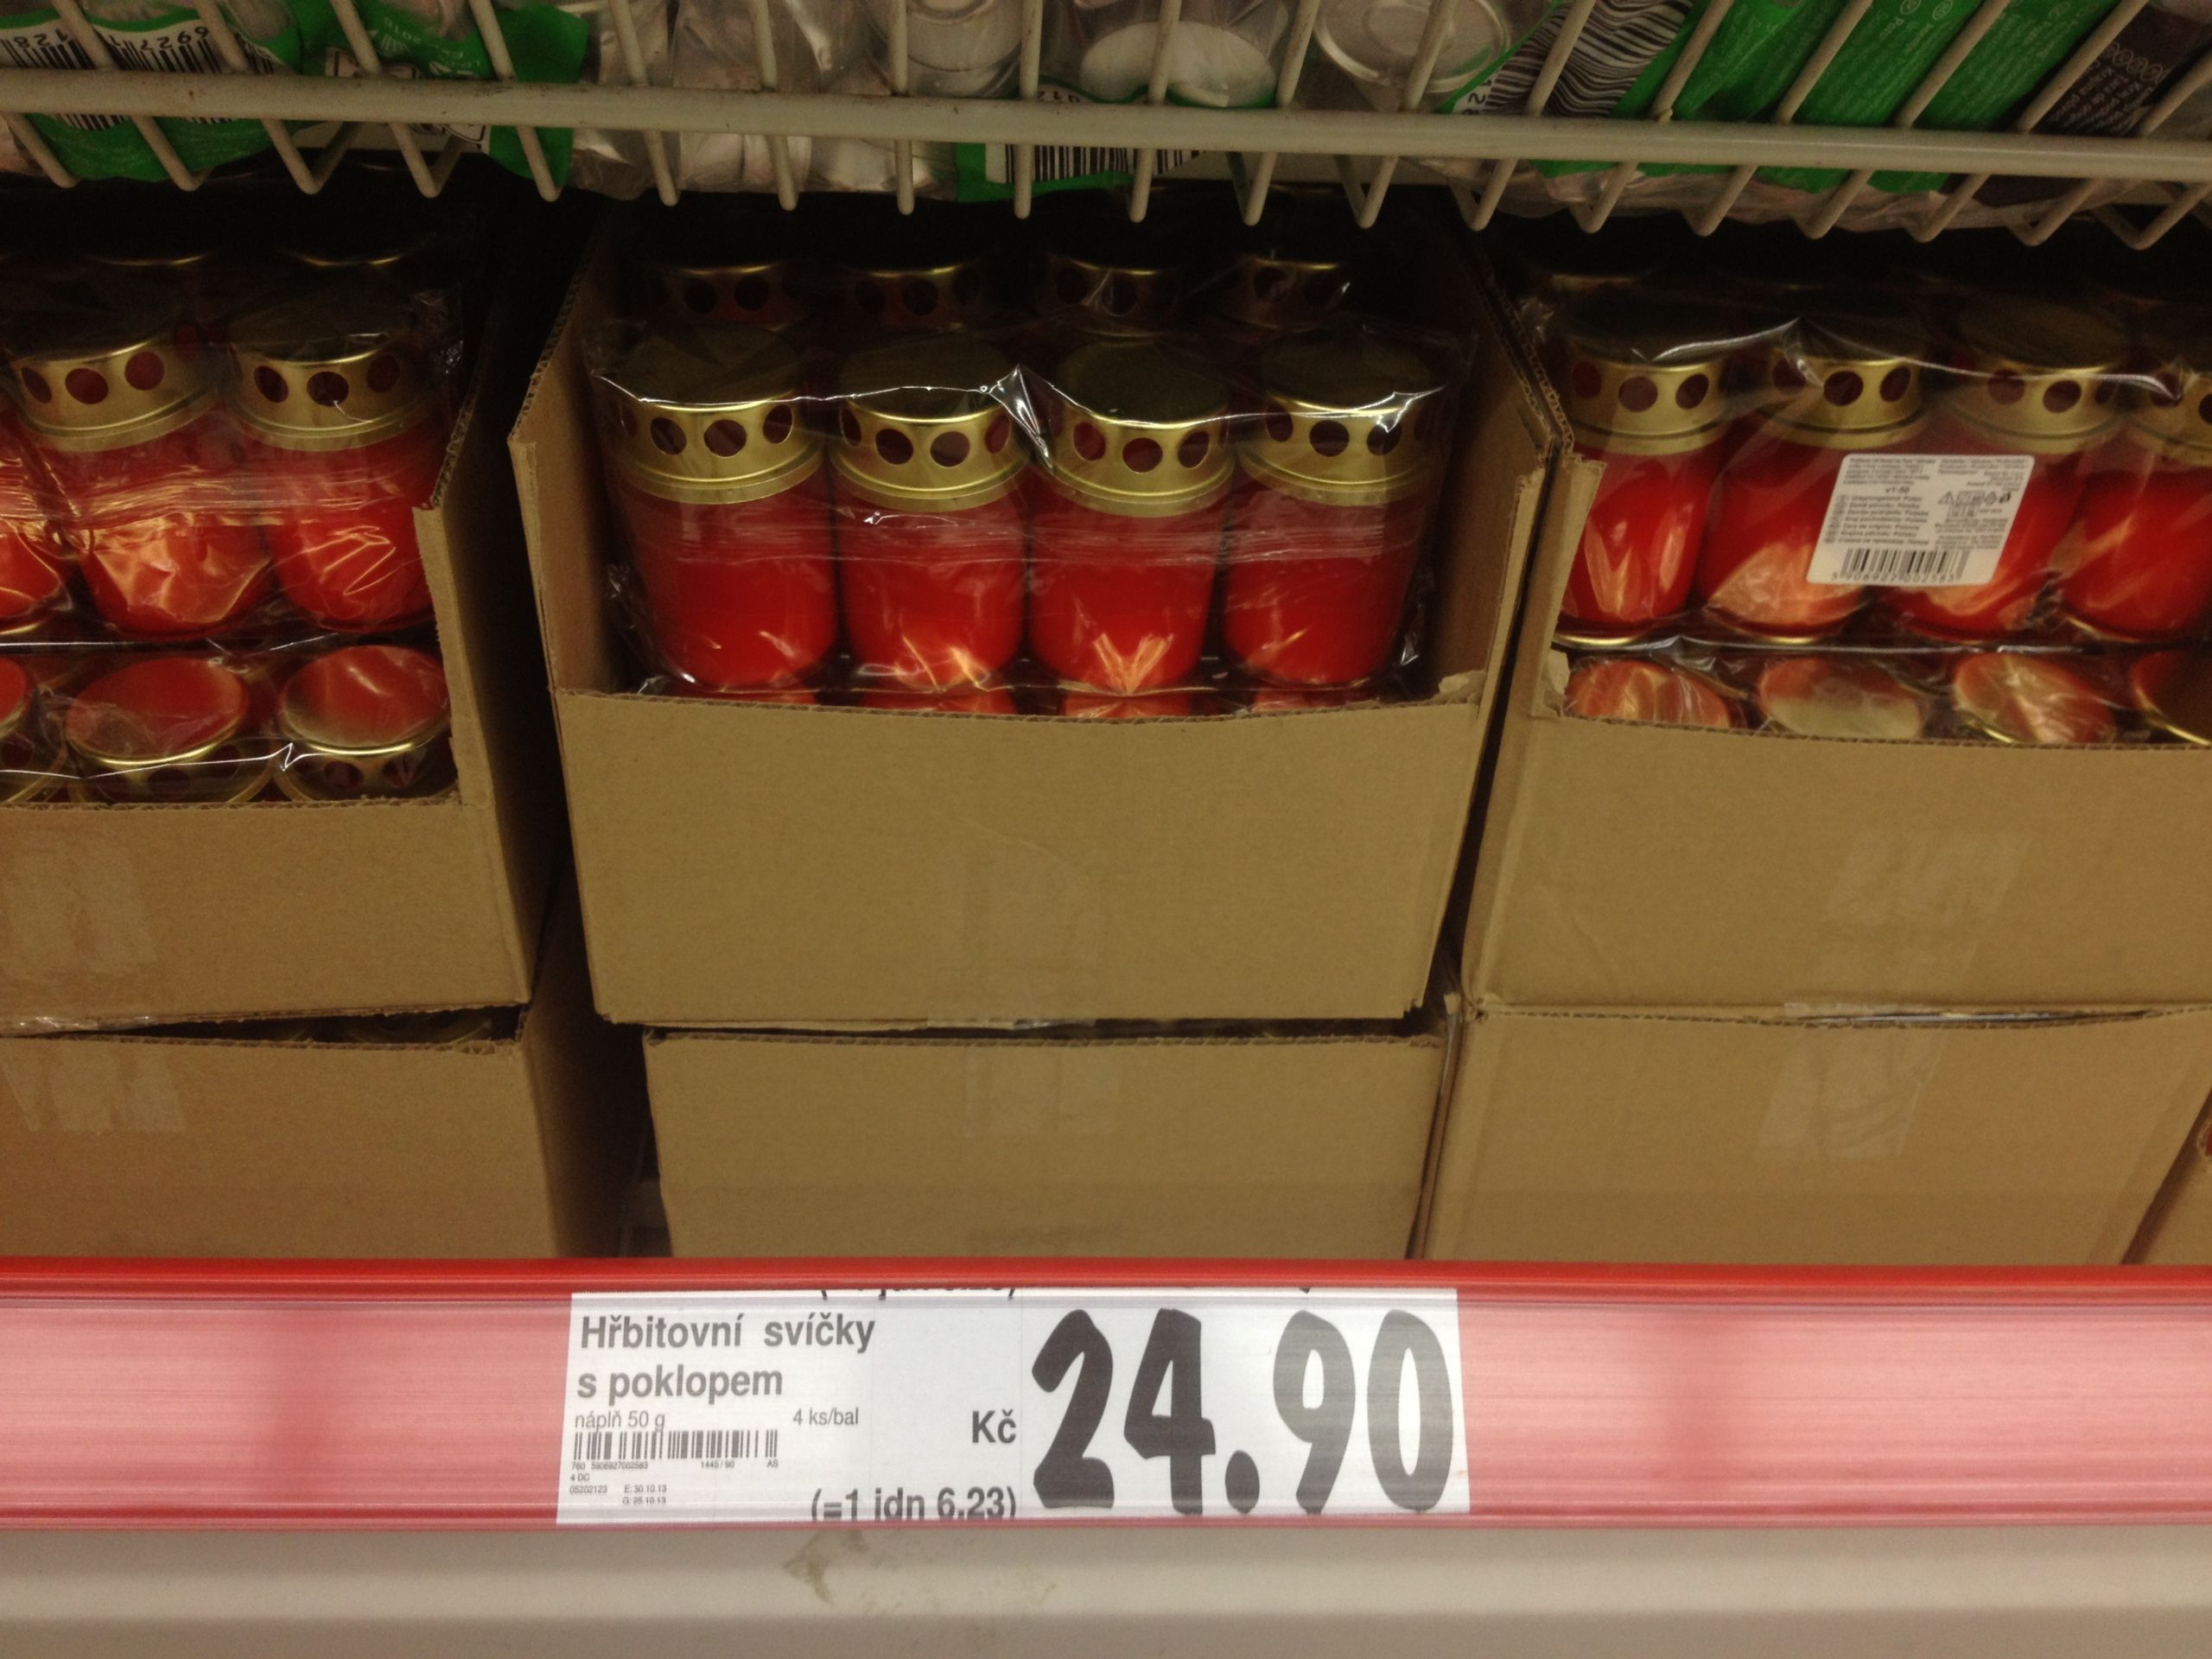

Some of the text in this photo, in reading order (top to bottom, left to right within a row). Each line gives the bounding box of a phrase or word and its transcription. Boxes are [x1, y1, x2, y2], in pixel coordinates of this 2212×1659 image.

[581, 1312, 875, 1353] Hřbitovní svíčky
[577, 1363, 783, 1407] s poklopem
[575, 1410, 665, 1433] náplň 50 g
[793, 1407, 859, 1426] 4 ks/bal
[971, 1408, 1017, 1444] Kč
